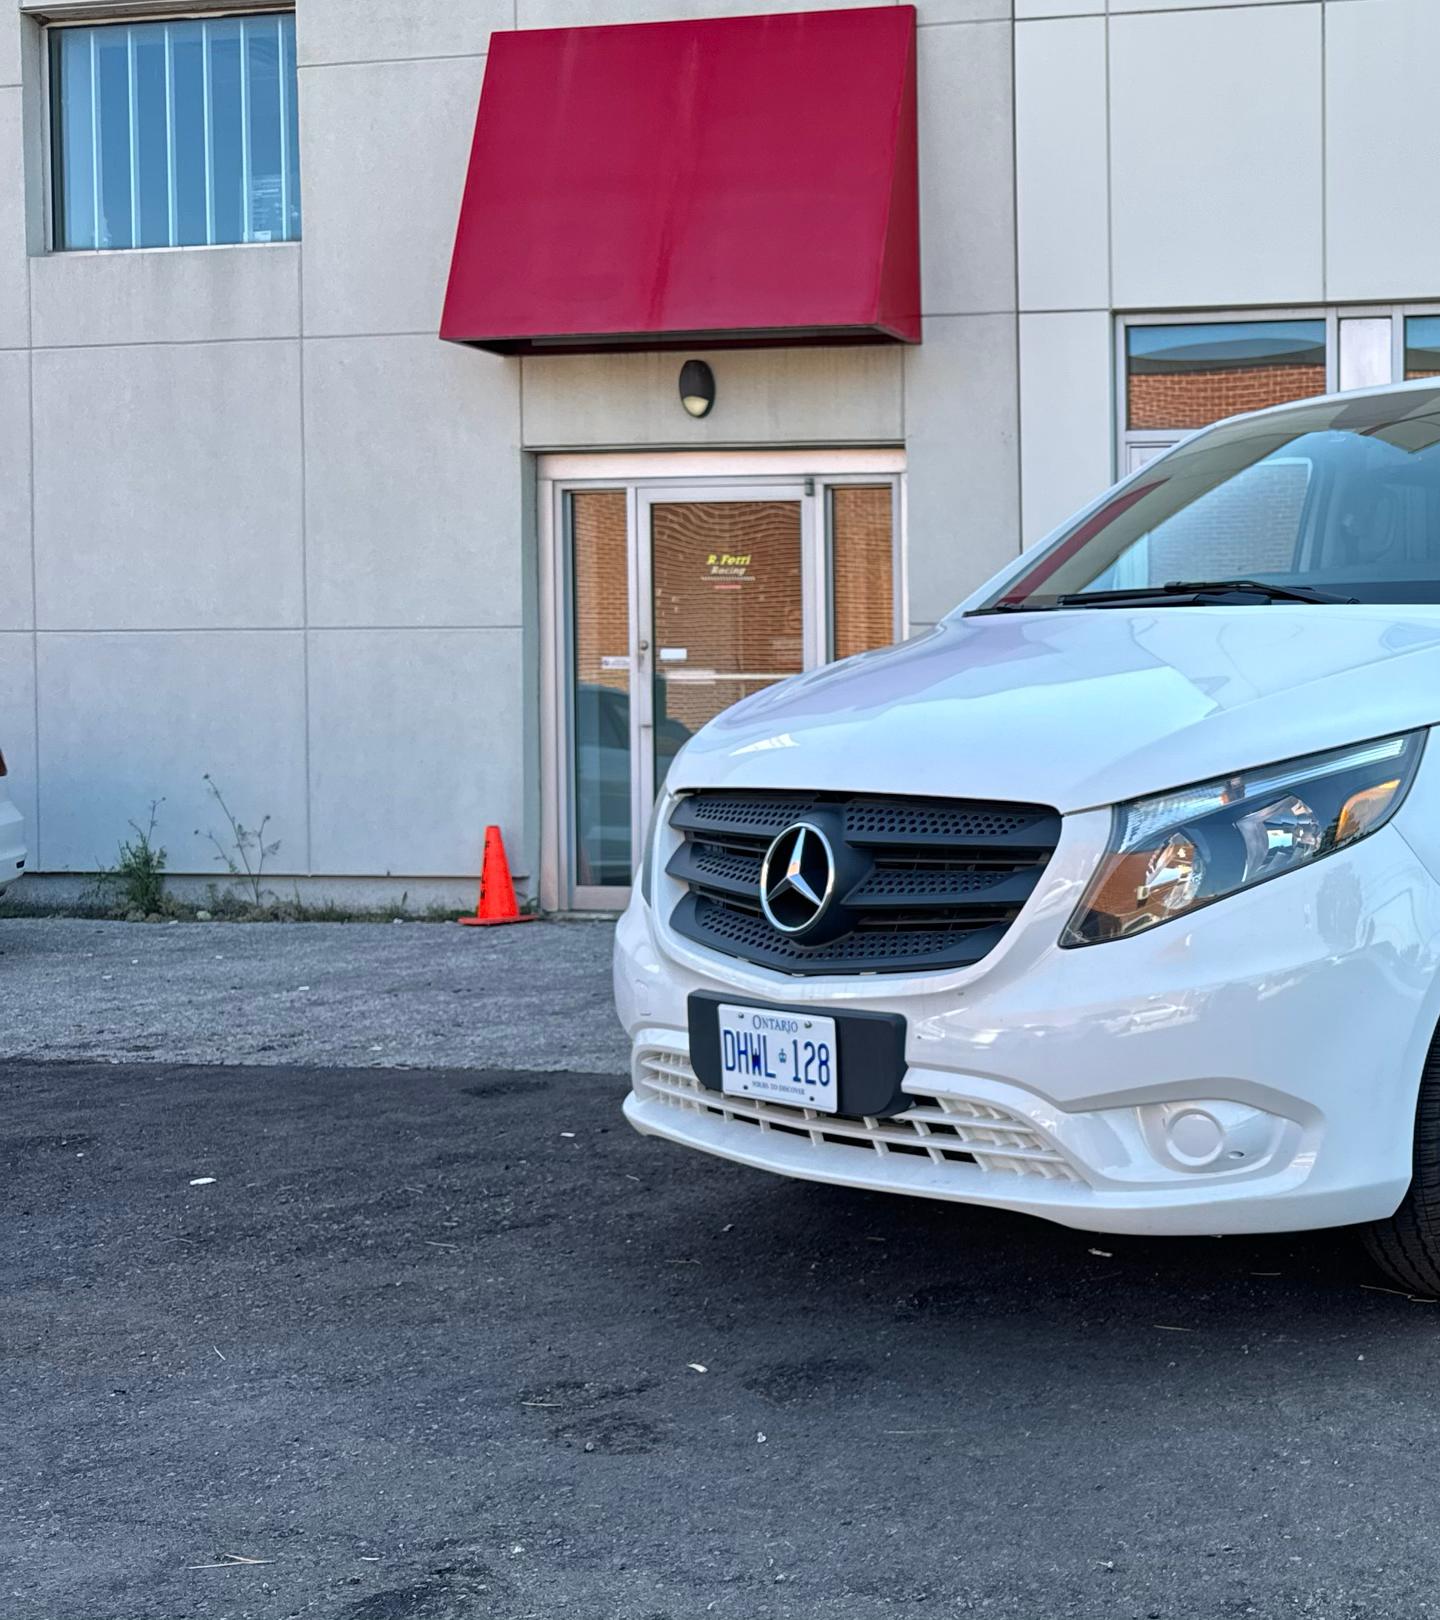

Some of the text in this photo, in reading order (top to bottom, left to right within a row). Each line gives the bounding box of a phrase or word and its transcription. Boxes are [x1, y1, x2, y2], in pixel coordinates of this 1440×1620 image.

[711, 566, 746, 576] Racing
[752, 1014, 798, 1033] ONTARIO
[723, 1029, 830, 1086] DHWL 128
